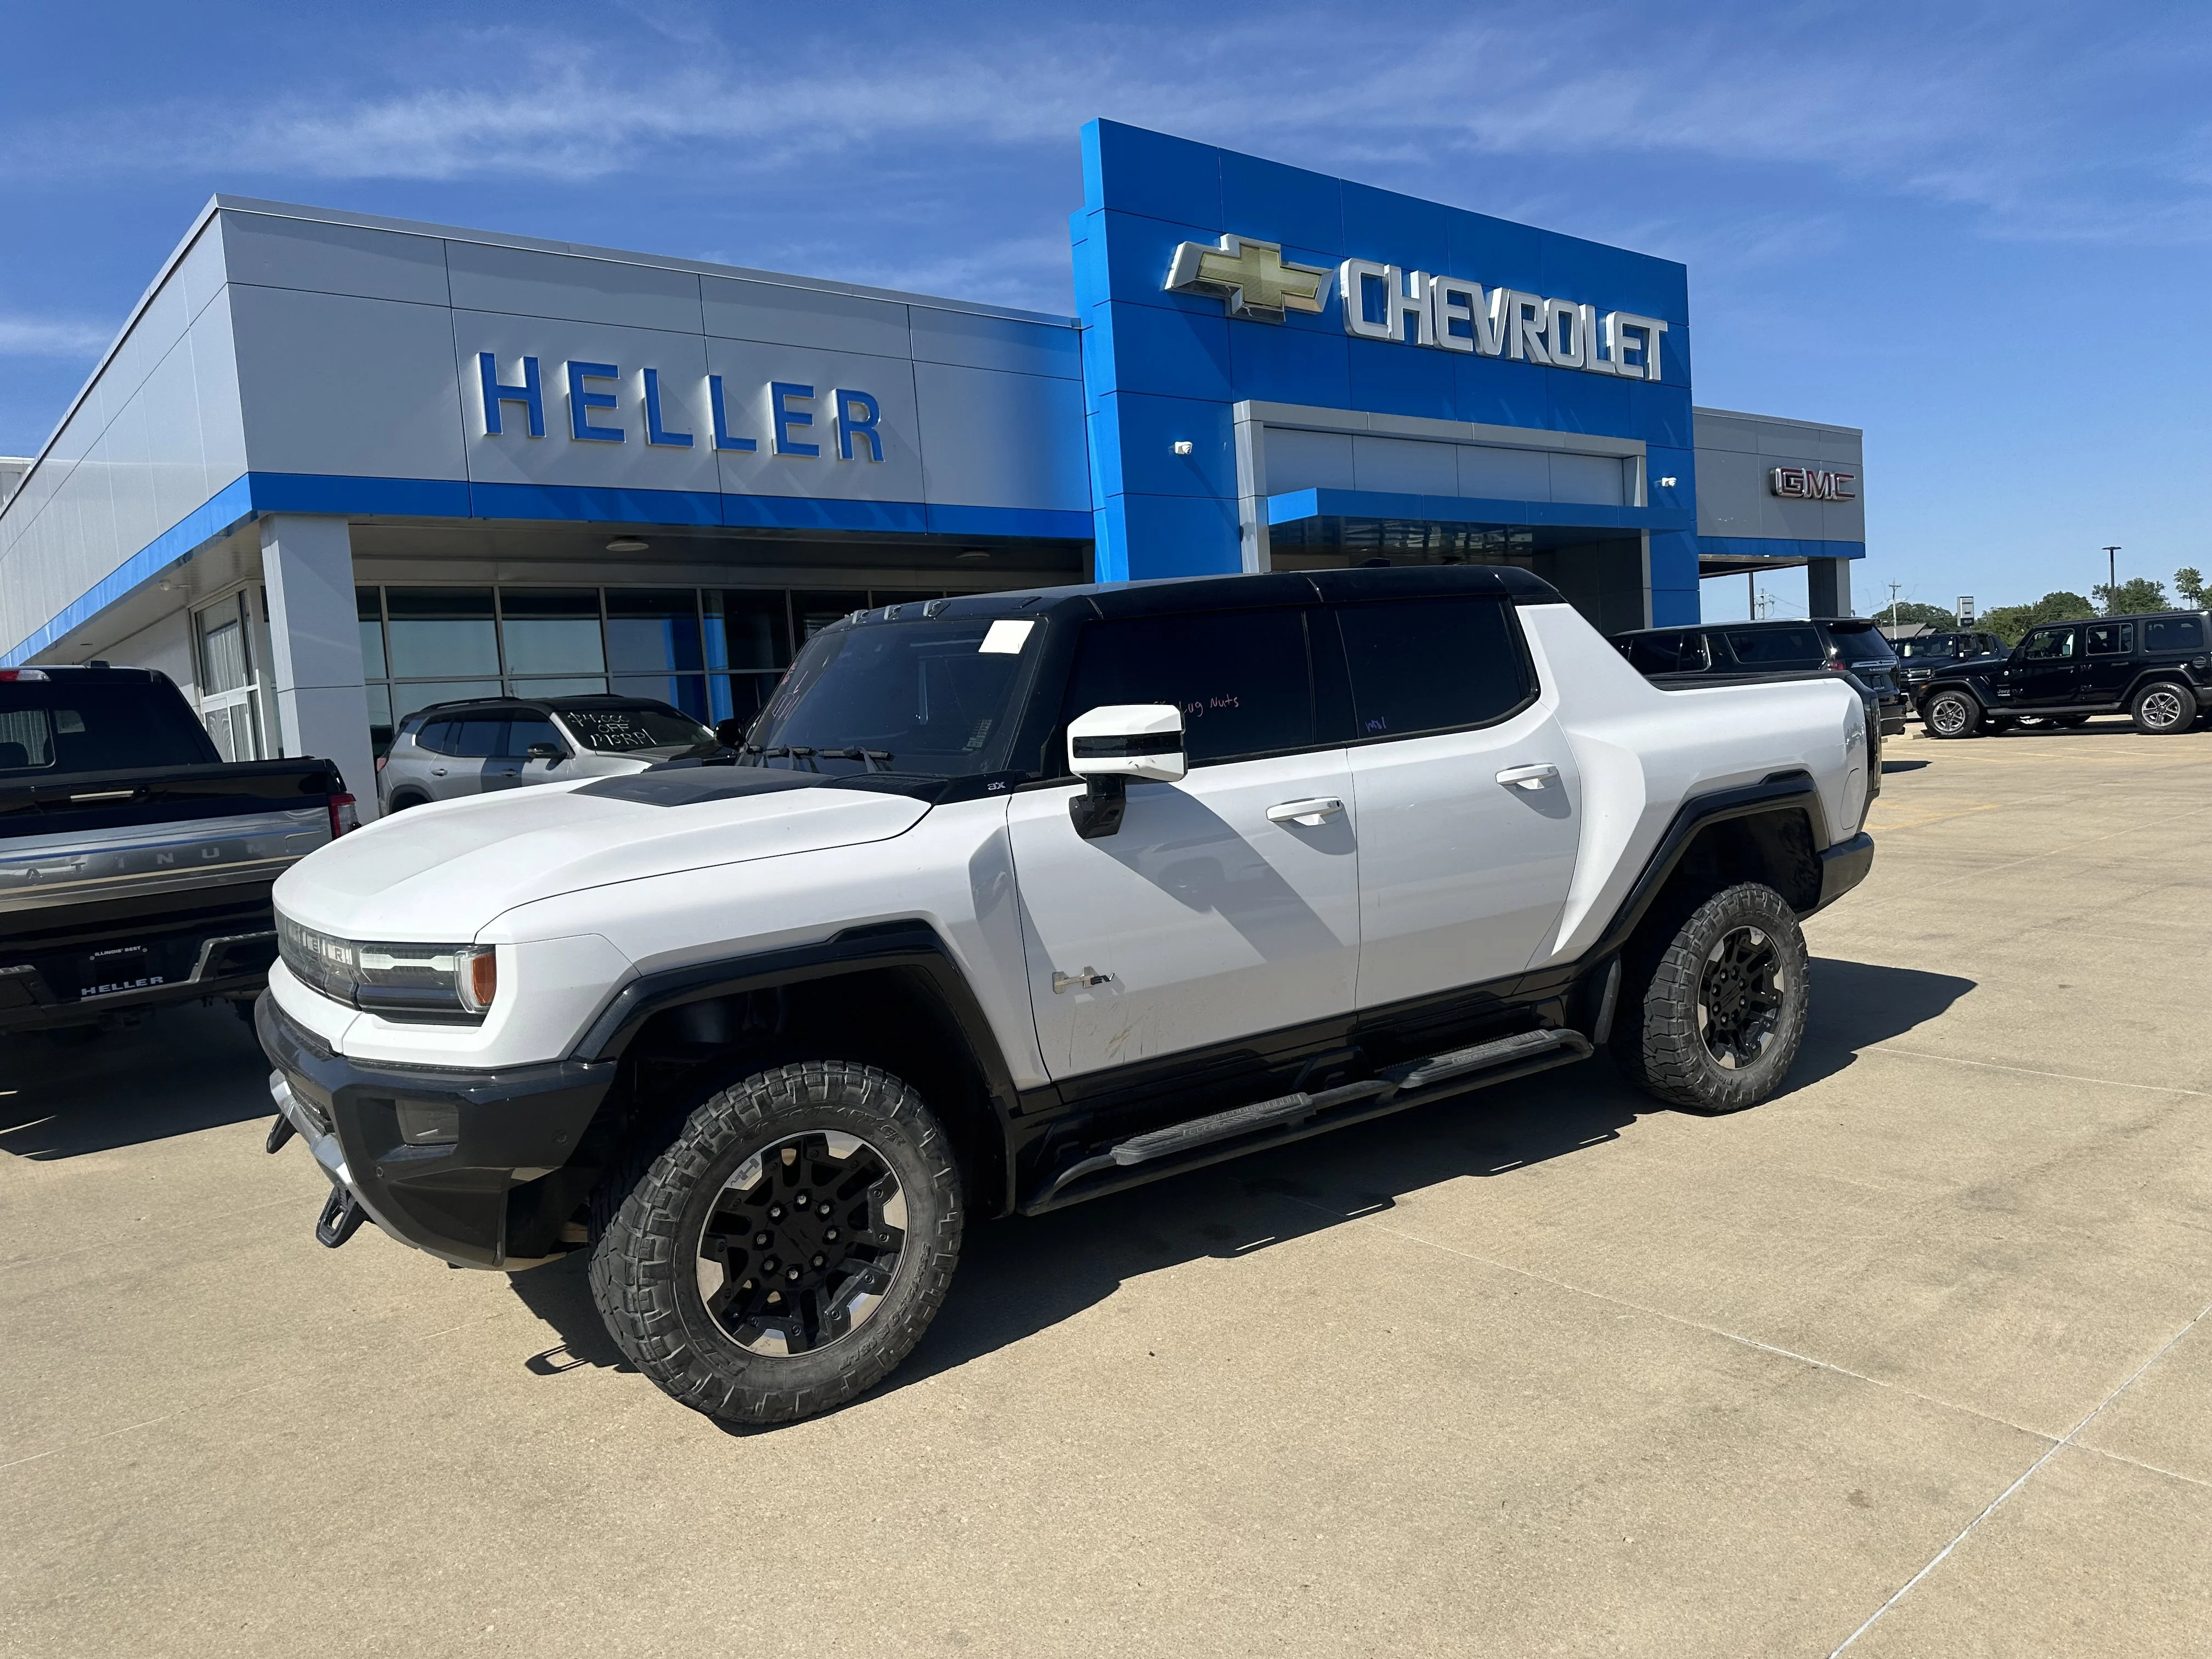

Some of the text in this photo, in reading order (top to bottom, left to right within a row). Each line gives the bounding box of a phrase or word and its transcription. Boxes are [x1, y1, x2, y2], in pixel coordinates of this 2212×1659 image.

[1340, 257, 1668, 381] CHEVROLET
[476, 352, 885, 463] HELLER
[1771, 467, 1856, 501] GMC
[1210, 693, 1239, 708] Nuts
[598, 723, 629, 733] OFF
[81, 976, 164, 996] HELLER
